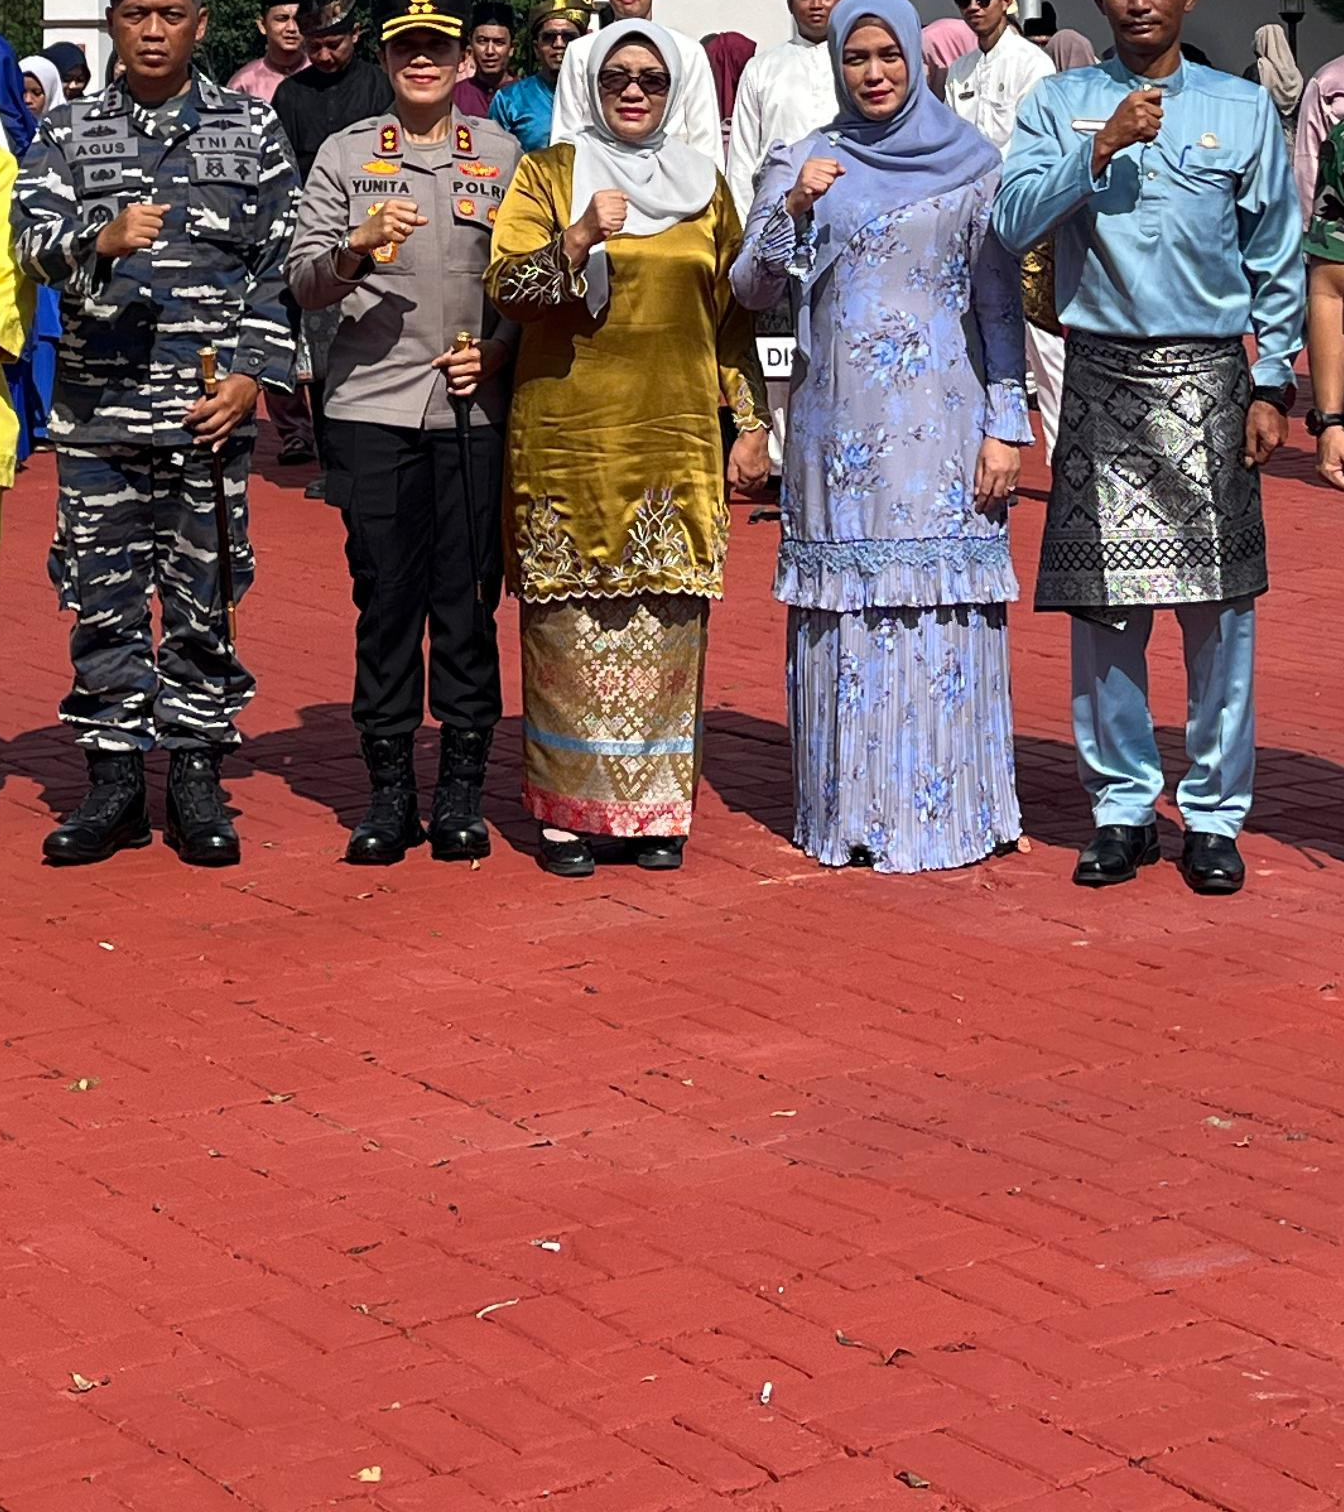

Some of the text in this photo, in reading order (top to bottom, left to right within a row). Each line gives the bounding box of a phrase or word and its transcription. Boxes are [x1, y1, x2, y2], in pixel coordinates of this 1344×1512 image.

[75, 141, 126, 157] AGUS
[196, 137, 256, 150] TNI AL
[352, 180, 410, 194] YUNITA
[453, 182, 505, 199] POLRI
[767, 347, 793, 366] DI
